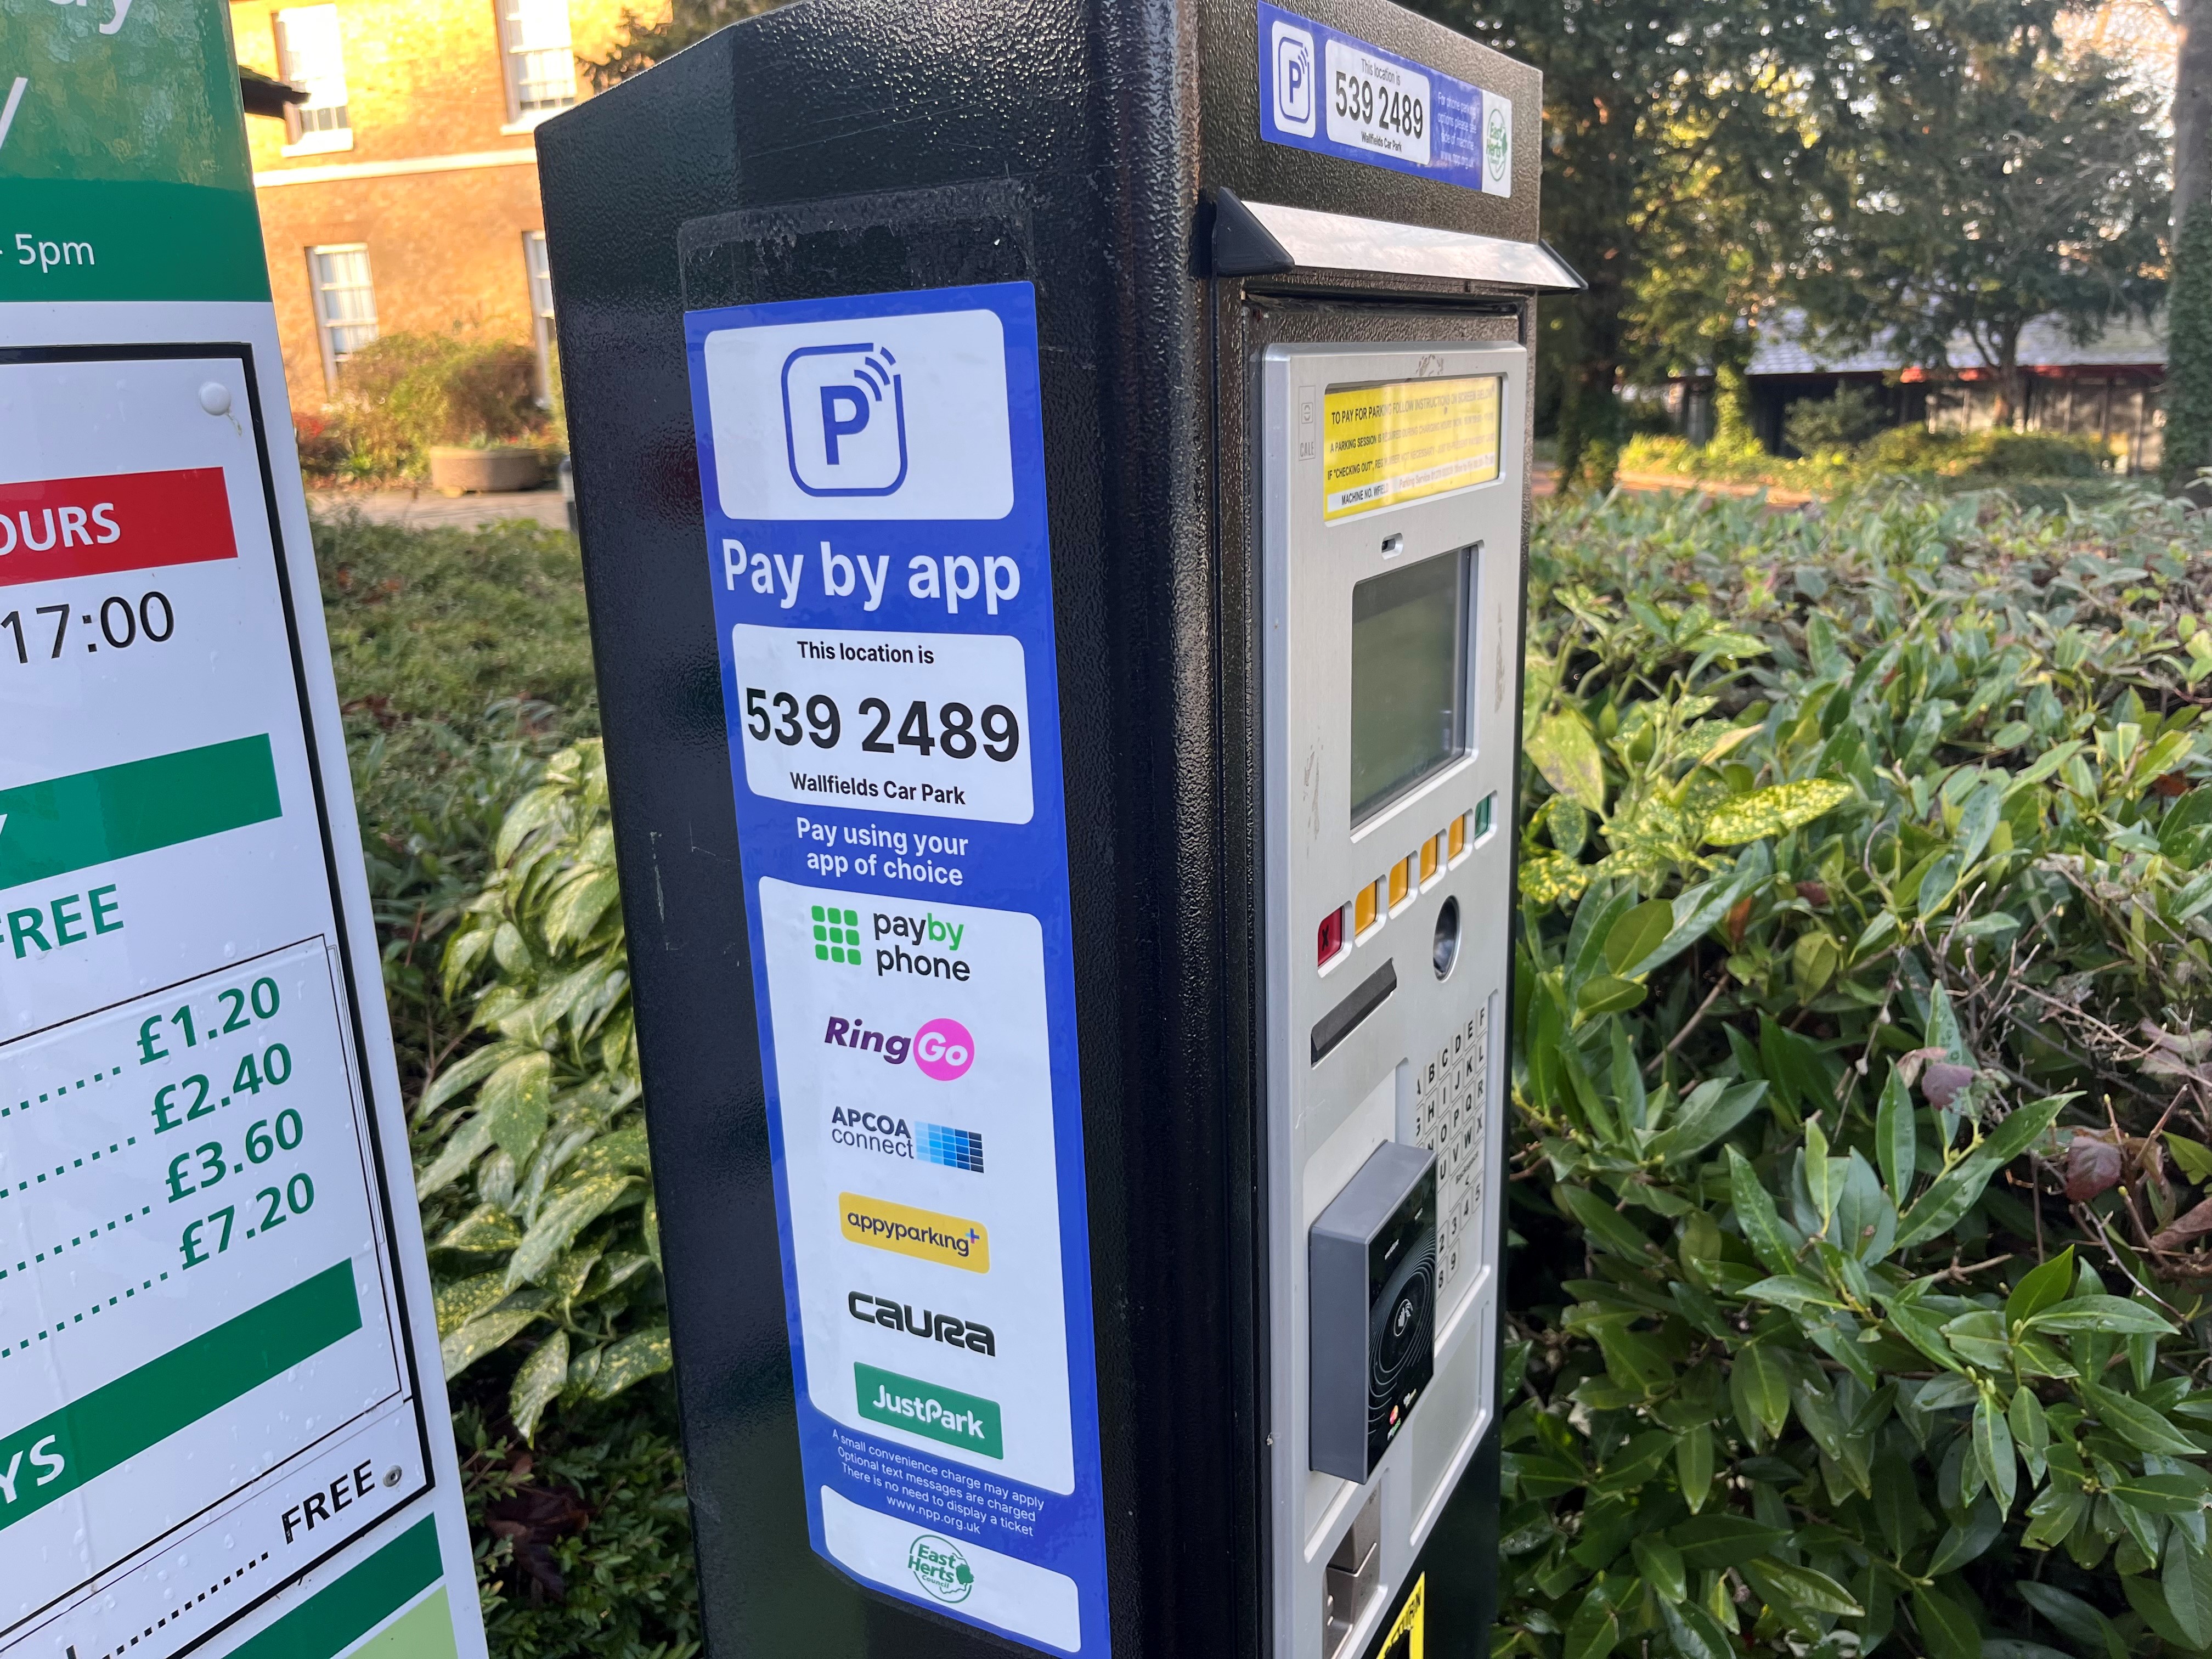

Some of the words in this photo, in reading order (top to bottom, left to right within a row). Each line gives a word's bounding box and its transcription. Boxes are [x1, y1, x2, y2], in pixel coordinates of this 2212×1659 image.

[1361, 58, 1373, 75] This
[1374, 63, 1395, 83] location
[1396, 71, 1400, 85] is
[1336, 71, 1373, 125] 539
[1379, 86, 1423, 139] 2489
[1361, 131, 1383, 148] Wallfields
[1392, 140, 1402, 152] Park
[15, 234, 95, 273] 5pm
[1331, 411, 1340, 425] TO
[1342, 409, 1353, 423] PAY
[1355, 408, 1367, 421] FOR
[1369, 403, 1392, 419] PARKING
[1393, 400, 1414, 415] FOLLOW
[1415, 394, 1450, 410] INSTRUCTIONS
[1300, 442, 1314, 457] CALE
[1330, 443, 1334, 453] A
[1335, 439, 1356, 452] PARKING
[1357, 435, 1377, 448] SESSION
[1378, 433, 1382, 443] IS
[1328, 470, 1332, 480] IF
[1334, 464, 1360, 478] "CHECKING
[1375, 459, 1383, 470] REG
[1341, 490, 1363, 505] MACHINE
[723, 539, 804, 609] Pay
[821, 541, 890, 611] by
[908, 555, 1020, 615] app
[1, 591, 174, 664] 17:00
[797, 641, 836, 659] This
[840, 643, 913, 663] location
[919, 645, 934, 664] is
[746, 687, 841, 749] 539
[858, 697, 1019, 762] 2489
[789, 772, 878, 797] Wallfields
[883, 781, 917, 800] Car
[922, 784, 966, 805] Park
[797, 817, 837, 847] Pay
[844, 823, 907, 853] using
[913, 834, 969, 857] your
[806, 851, 849, 877] app
[854, 851, 877, 876] of
[884, 857, 963, 886] choice
[0, 884, 124, 959] REE
[876, 945, 970, 981] phone
[137, 977, 280, 1065] £1.20
[1429, 1063, 1435, 1084] B
[1442, 1048, 1448, 1067] C
[1455, 1034, 1461, 1054] D
[1468, 1019, 1473, 1040] E
[1480, 1007, 1485, 1026] F
[150, 1042, 292, 1135] £2.40
[1428, 1100, 1434, 1122] H
[1455, 1070, 1460, 1090] J
[1466, 1056, 1472, 1077] K
[1479, 1045, 1483, 1062] L
[832, 1106, 912, 1139] APCOA
[1441, 1124, 1447, 1143] O
[1454, 1108, 1459, 1128] P
[1466, 1093, 1471, 1111] Q
[1477, 1079, 1483, 1098] R
[165, 1108, 303, 1203] £3.60
[832, 1127, 915, 1159] connect
[1440, 1159, 1446, 1180] U
[1453, 1143, 1459, 1163] V
[1464, 1126, 1471, 1148] W
[1477, 1113, 1482, 1134] X
[179, 1172, 314, 1270] £7.20
[1439, 1234, 1444, 1253] 2
[1452, 1216, 1457, 1234] 3
[1475, 1183, 1480, 1201] 5
[1451, 1252, 1456, 1271] 9
[873, 1384, 986, 1439] JustPark
[832, 1429, 839, 1441] A
[841, 1435, 866, 1452] small
[868, 1446, 938, 1475] convenience
[941, 1468, 981, 1489] charge
[984, 1483, 1008, 1500] may
[1012, 1490, 1045, 1511] apply
[838, 1446, 878, 1471] Optional
[882, 1465, 904, 1479] text
[906, 1472, 963, 1498] messages
[966, 1493, 984, 1505] are
[988, 1499, 1036, 1522] charged
[281, 1459, 375, 1544] FREE
[842, 1462, 871, 1482] There
[873, 1475, 883, 1486] is
[885, 1480, 899, 1492] no
[902, 1486, 929, 1503] need
[932, 1495, 944, 1506] to
[947, 1499, 988, 1523] display
[990, 1514, 998, 1525] a
[1000, 1516, 1034, 1536] ticket
[887, 1496, 981, 1534] www.npp.org.uk
[908, 1555, 954, 1583] Herts
[918, 1543, 956, 1568] East
[922, 1575, 950, 1588] Council
